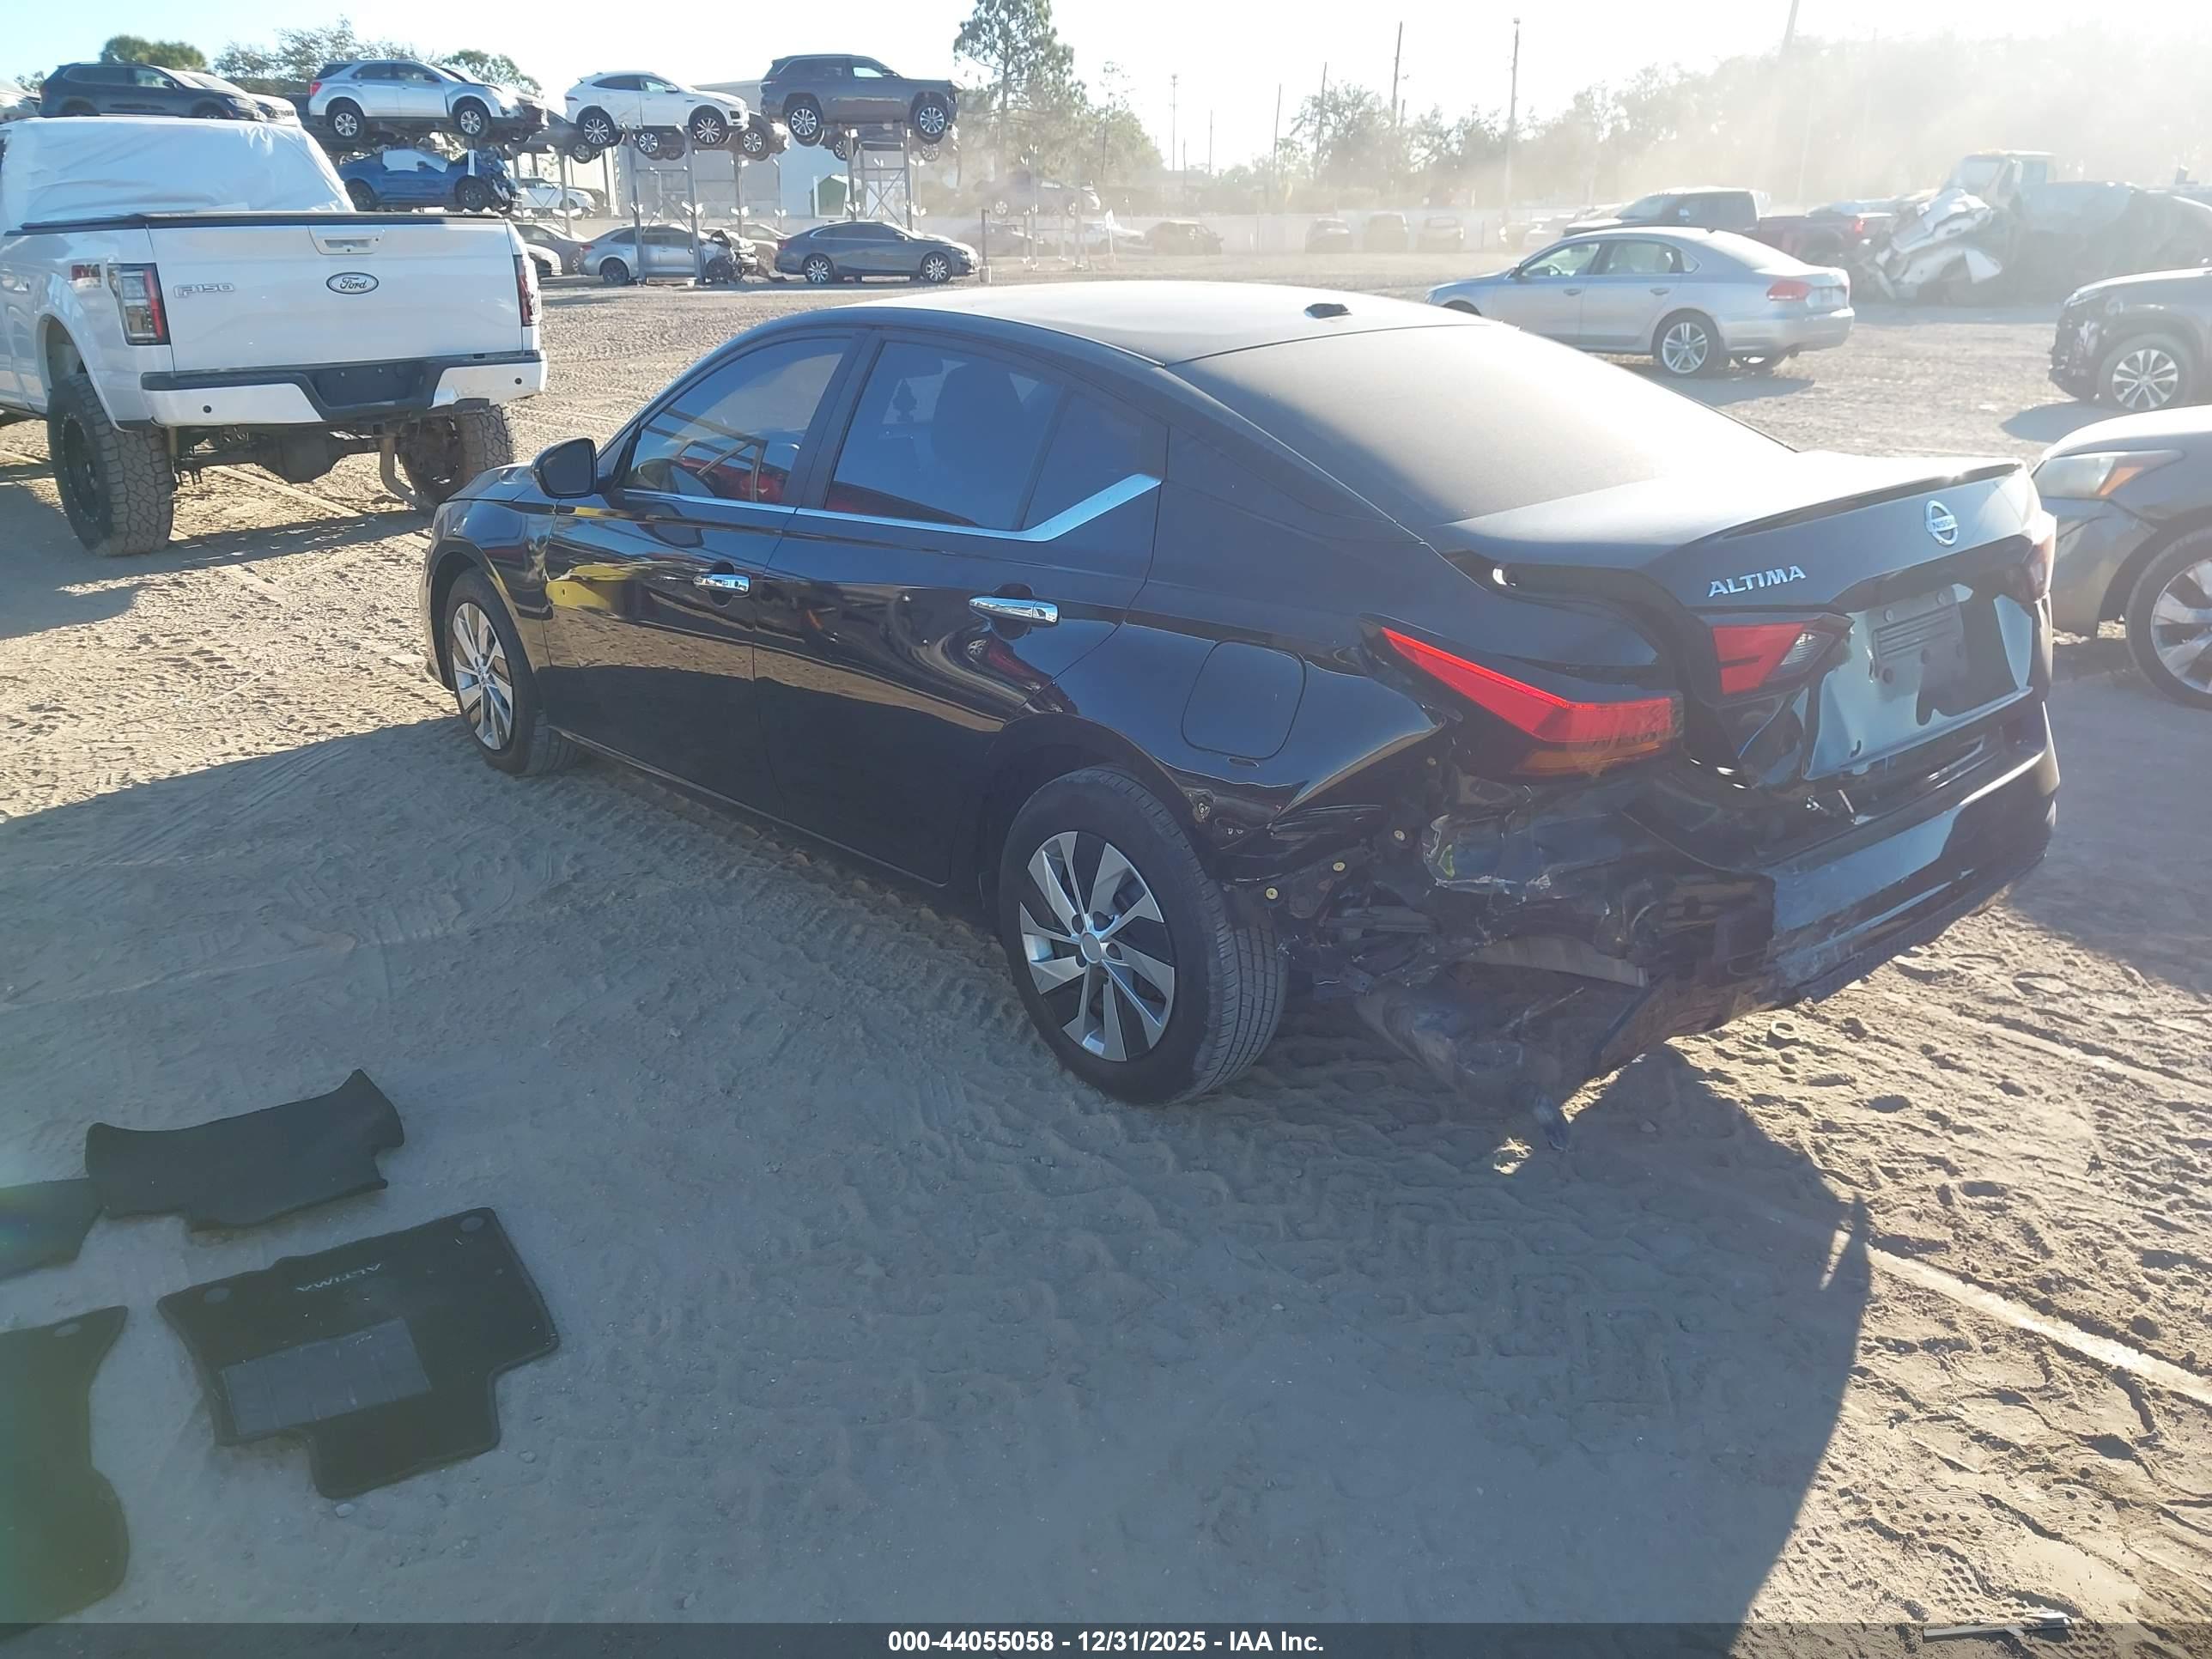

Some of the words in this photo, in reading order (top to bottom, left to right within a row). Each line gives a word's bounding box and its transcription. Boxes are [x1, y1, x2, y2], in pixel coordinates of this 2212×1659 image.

[339, 276, 368, 289] Ford
[1708, 565, 1807, 598] ALTIMA
[295, 1262, 381, 1291] ALTIMA
